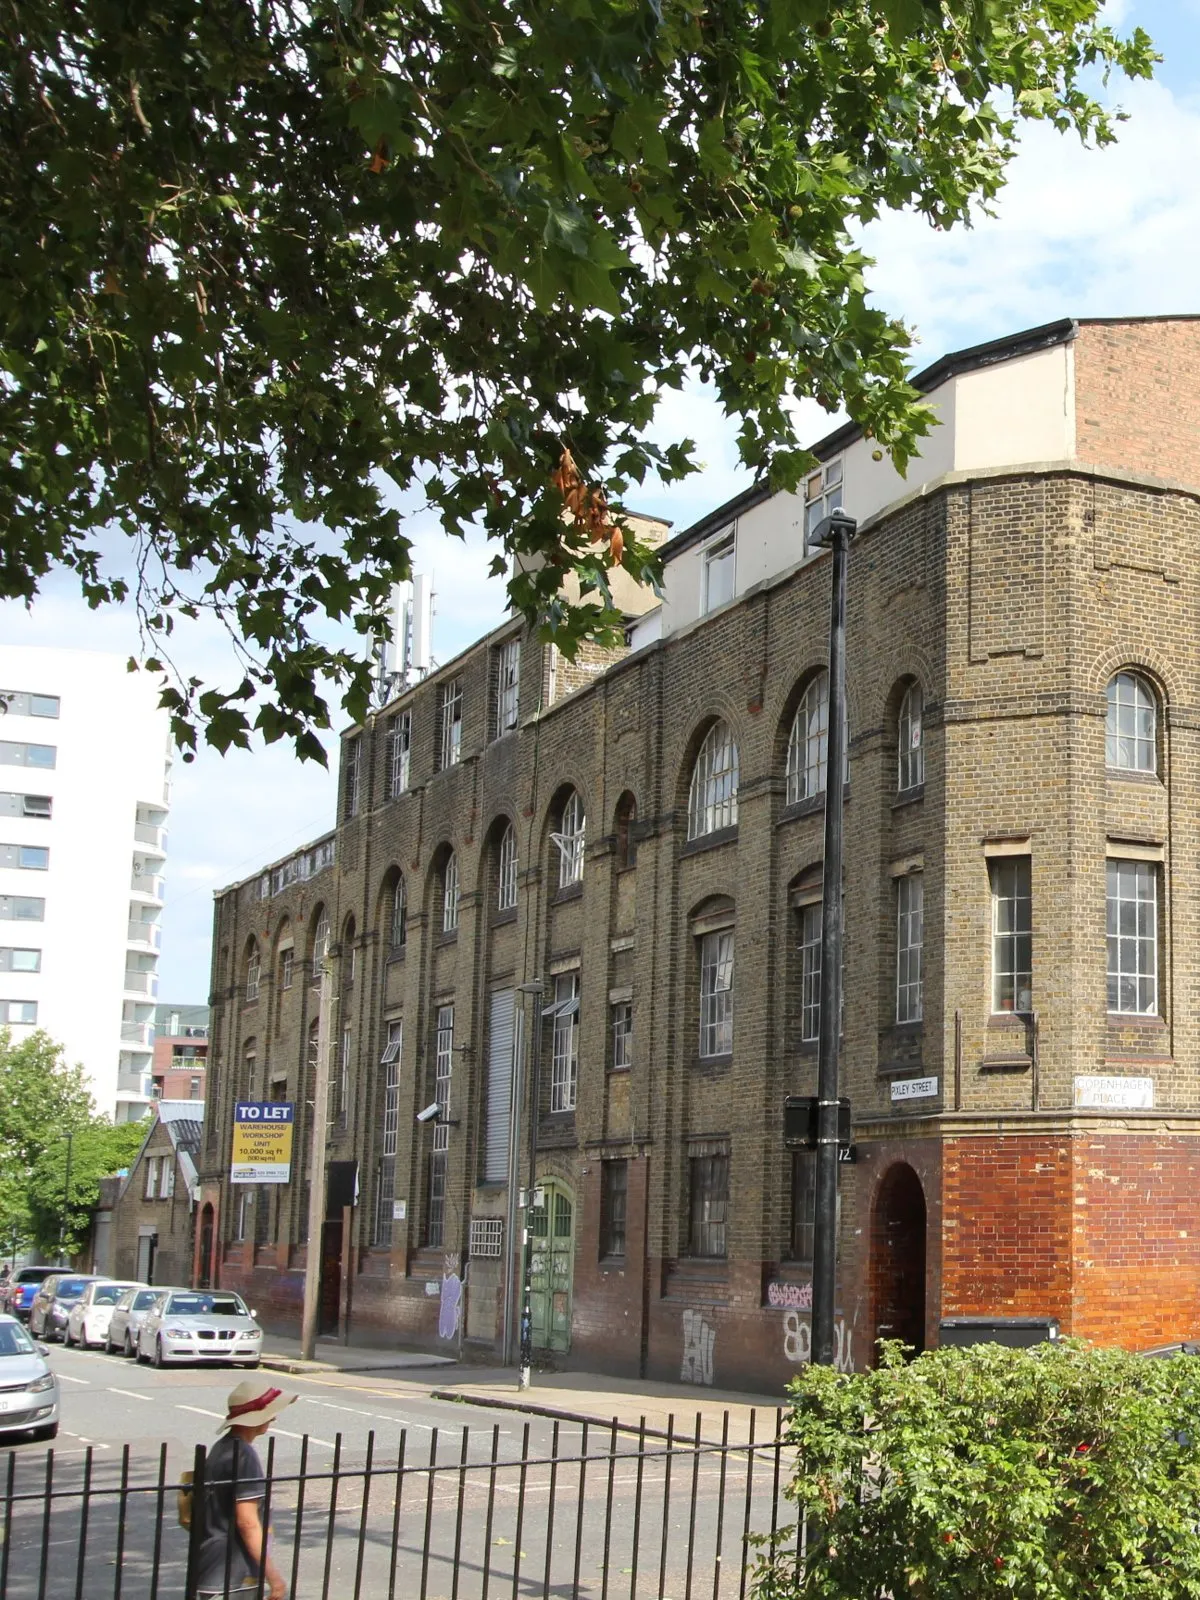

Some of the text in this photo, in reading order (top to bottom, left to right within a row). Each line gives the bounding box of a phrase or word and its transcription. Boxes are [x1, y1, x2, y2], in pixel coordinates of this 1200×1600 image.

[911, 1081, 933, 1093] STREET
[1076, 1079, 1152, 1090] COPENHAGEN
[1092, 1093, 1127, 1104] PLACE
[239, 1106, 290, 1119] TO LET
